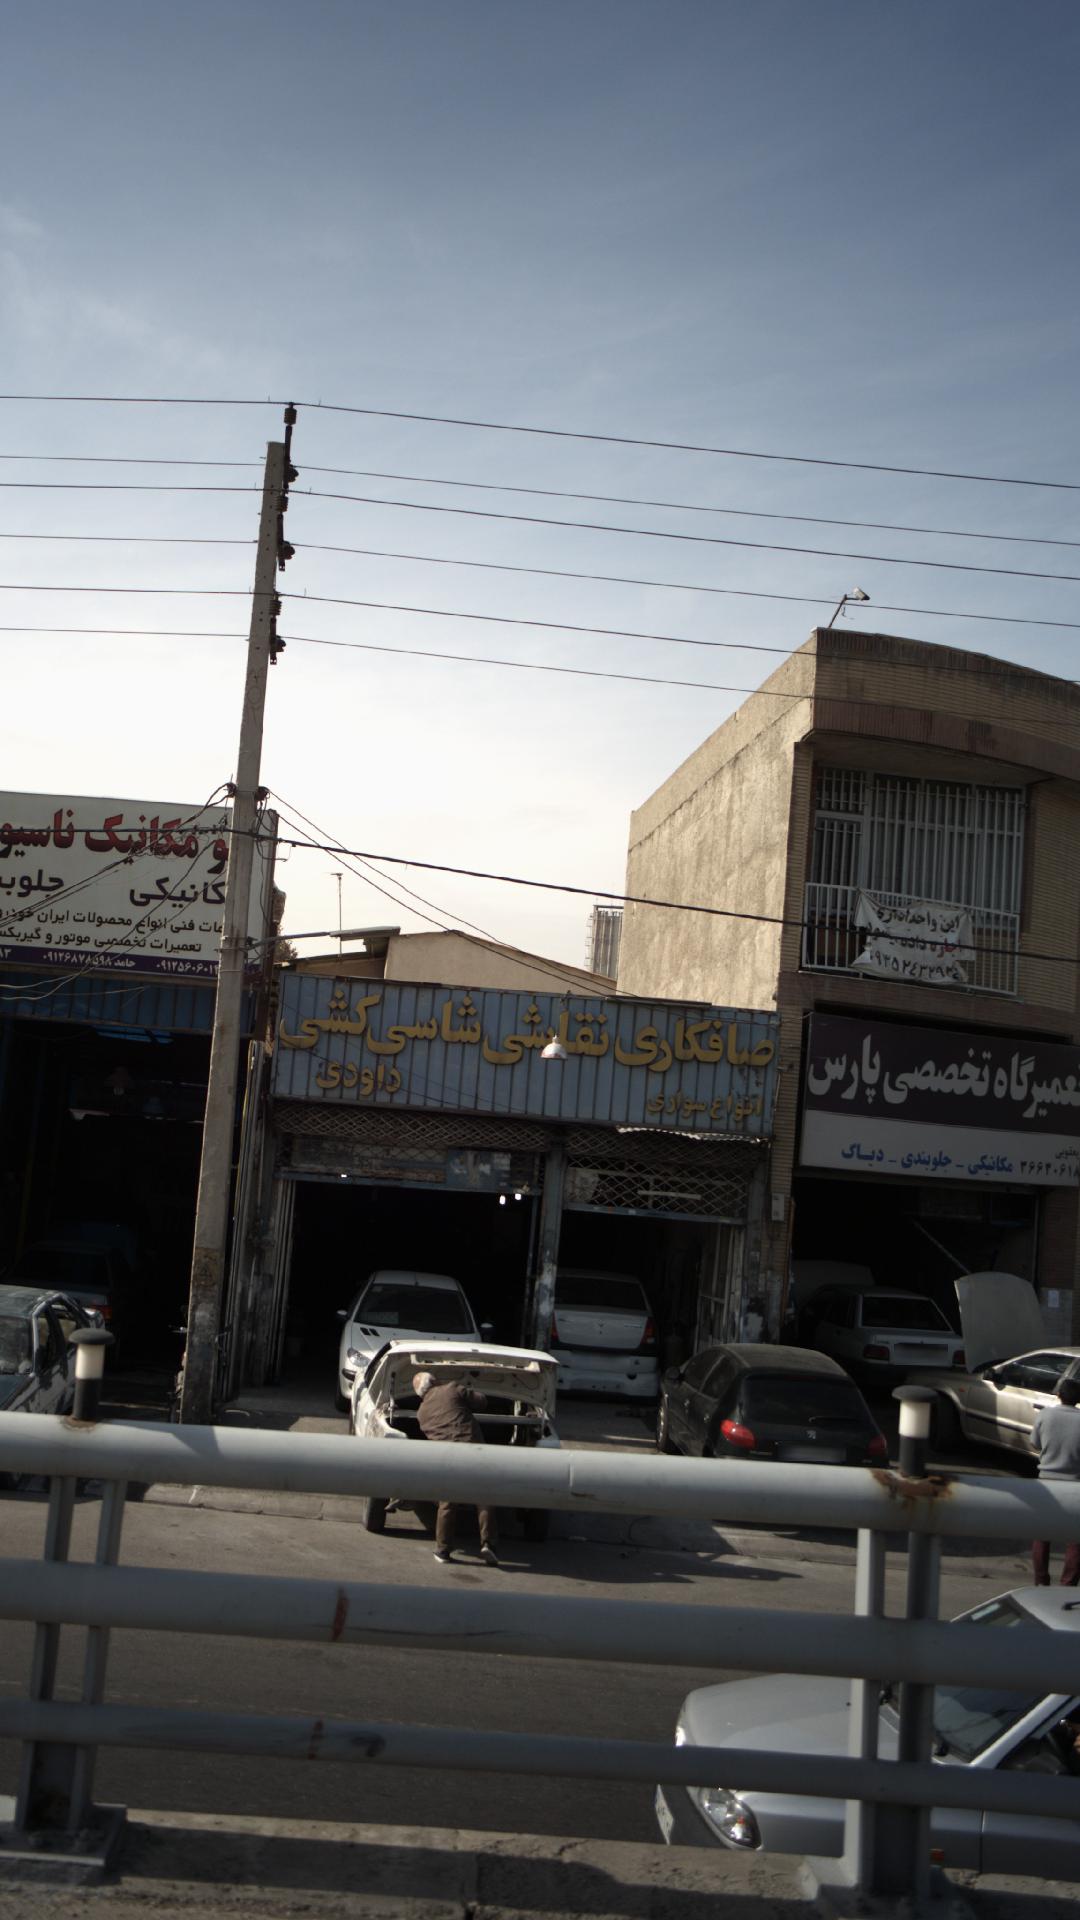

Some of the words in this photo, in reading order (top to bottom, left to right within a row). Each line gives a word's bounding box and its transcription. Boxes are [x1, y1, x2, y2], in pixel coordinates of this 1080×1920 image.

[85, 814, 200, 864] مکانیک
[129, 877, 225, 908] کانیکی
[37, 909, 70, 924] ایران
[73, 911, 132, 927] محصولات
[135, 916, 167, 934] انواع
[170, 919, 195, 933] فنی
[45, 932, 52, 943] و
[55, 933, 90, 945] موتور
[94, 936, 147, 948] تخصصی
[150, 938, 202, 953] تعمیرات
[279, 990, 382, 1050] کشی
[365, 996, 482, 1054] شاسی
[482, 1004, 610, 1065] نقاشی
[615, 1017, 775, 1072] صافکاری
[315, 1061, 401, 1096] داودی
[807, 1034, 881, 1104] پارس
[883, 1047, 992, 1104] تخصصی
[646, 1089, 707, 1118] سواری
[710, 1090, 763, 1121] انواع
[901, 1150, 953, 1173] جلوبندی
[968, 1155, 1013, 1176] مکانیکی
